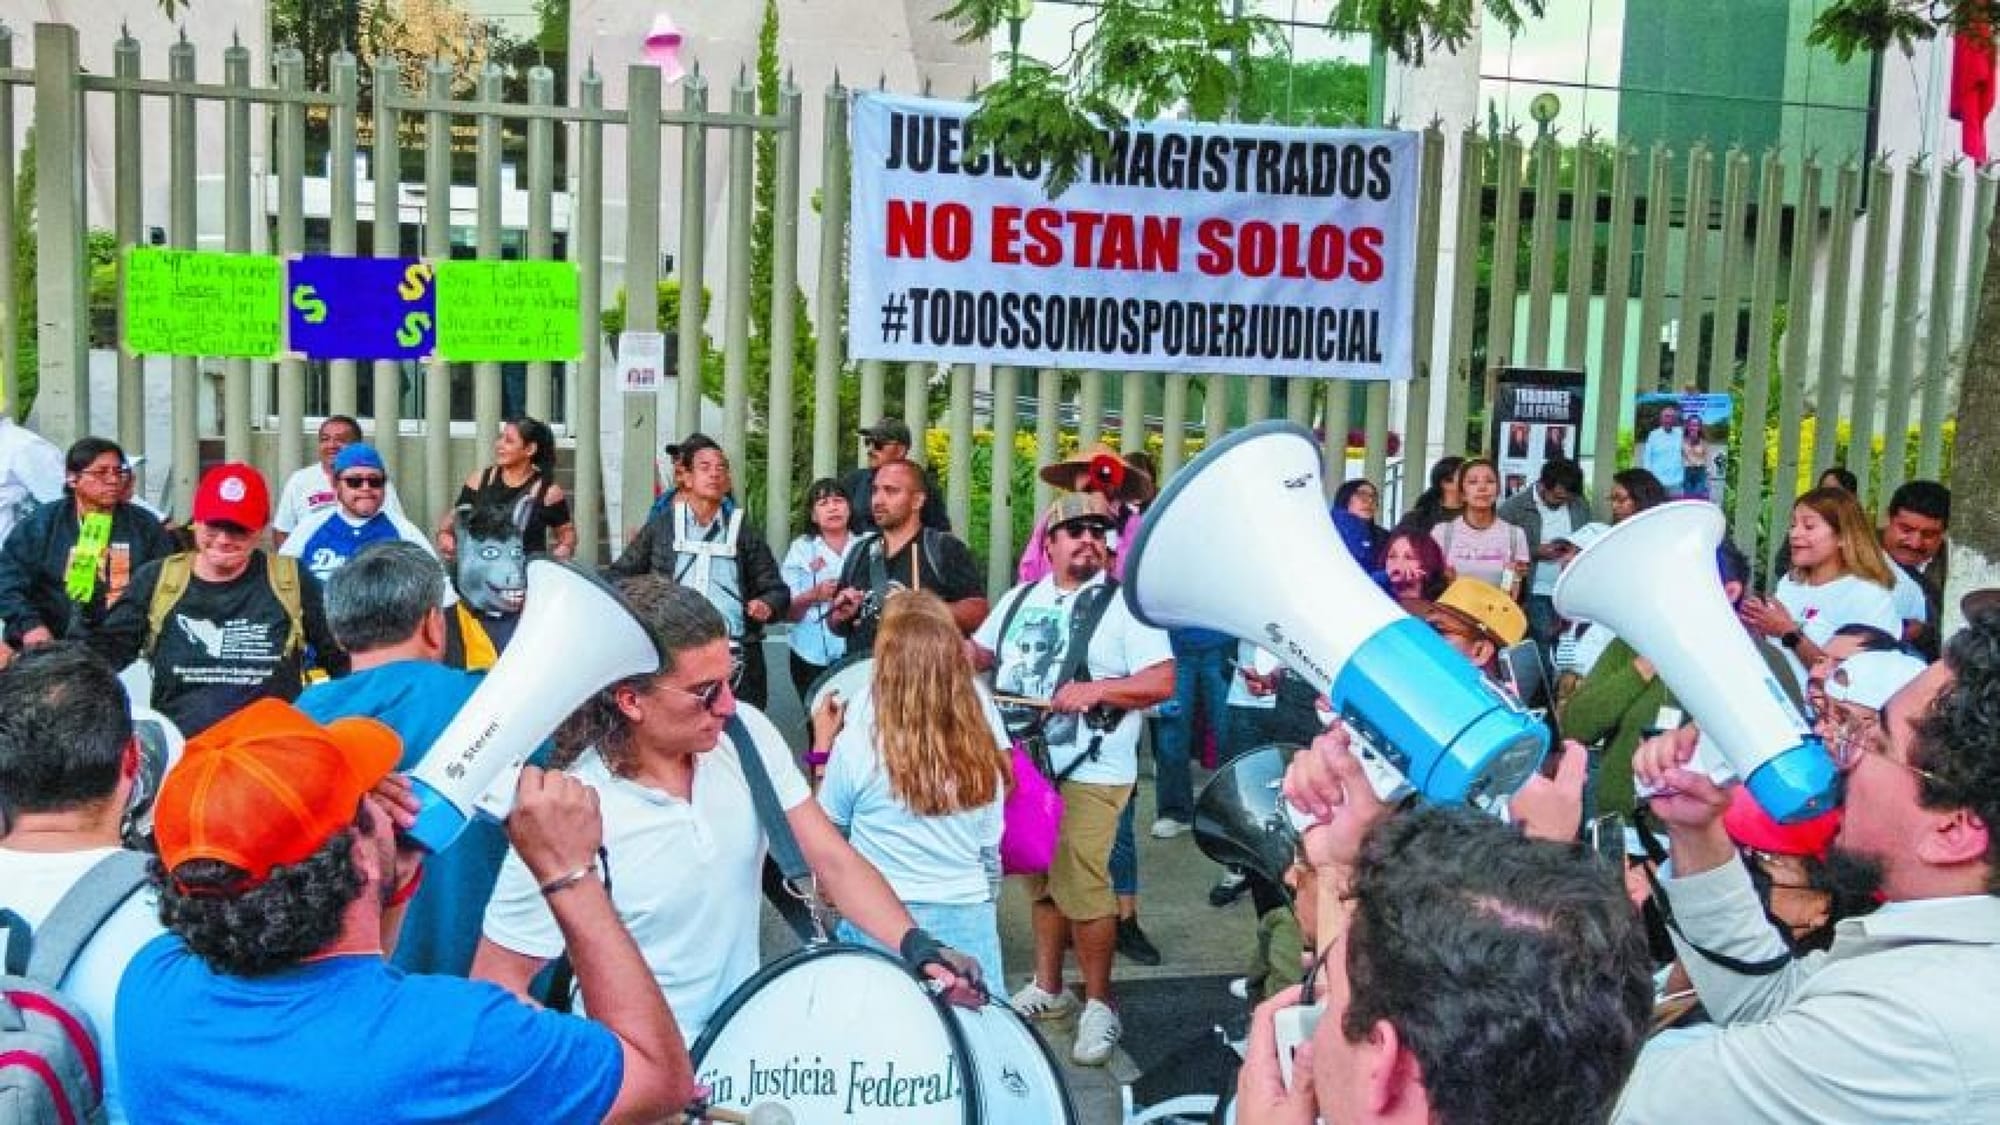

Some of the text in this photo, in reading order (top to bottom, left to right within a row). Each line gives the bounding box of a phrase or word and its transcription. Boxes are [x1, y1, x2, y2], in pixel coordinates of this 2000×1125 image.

[1091, 127, 1392, 200] MAGISTRADOS
[885, 200, 1384, 283] NO ESTAN SOLOS
[881, 287, 1383, 364] #TODOSSOMOSPODERJUDICIAL
[463, 721, 500, 763] Steren
[740, 1054, 838, 1107] Justicia
